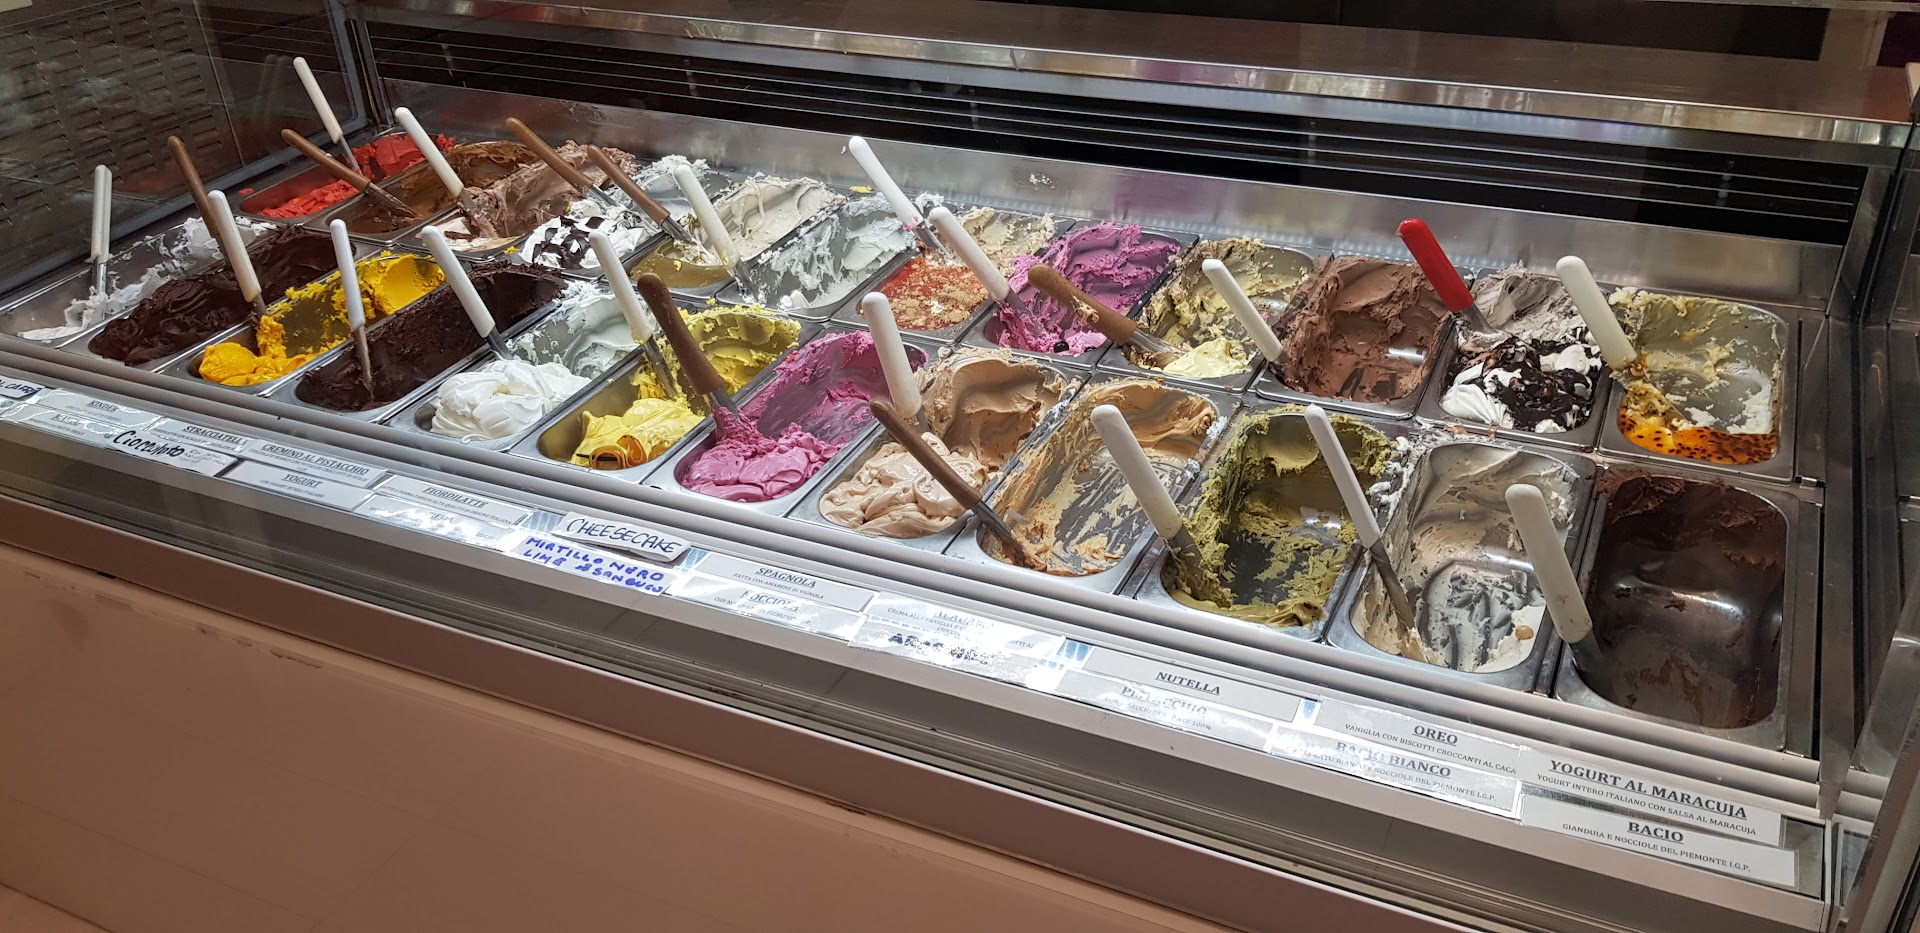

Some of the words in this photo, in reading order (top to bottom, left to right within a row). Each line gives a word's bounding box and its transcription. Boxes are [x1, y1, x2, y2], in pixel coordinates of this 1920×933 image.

[262, 444, 304, 460] CREMINO
[299, 453, 314, 462] AL
[315, 457, 369, 476] PISTACCHIO
[282, 473, 323, 489] YOGURT
[422, 486, 488, 508] FIORDILATTE
[566, 518, 682, 554] CHEESECAKE
[526, 537, 604, 564] MIRTILLO
[610, 561, 664, 581] NERO
[755, 567, 816, 589] SPAGNOLA
[1154, 671, 1221, 696] NUTELLA
[1345, 723, 1381, 739] VANIGLIA
[1382, 733, 1399, 743] CON
[1399, 737, 1435, 753] BISCOTTI
[1436, 746, 1482, 765] CROCCANTI
[1483, 759, 1494, 768] AL
[1495, 762, 1517, 775] CACA
[1411, 725, 1458, 747] OREO
[1389, 751, 1451, 779] BIANCO
[1374, 768, 1414, 782] NOCCIOLE
[1415, 776, 1431, 786] DEL
[1433, 780, 1476, 797] PIEMONTE
[1548, 759, 1621, 785] YOGURT
[1625, 780, 1647, 794] AL
[1652, 785, 1748, 820] MARACUJA
[1537, 773, 1571, 788] YOGURT
[1572, 782, 1604, 796] INTERO
[1605, 790, 1646, 807] ITALIANO
[1647, 802, 1666, 813] CON
[1667, 807, 1695, 820] SALSA
[1696, 814, 1708, 823] AL
[1709, 817, 1757, 836] MARACUJA
[1562, 823, 1605, 839] GIANDUIA
[1607, 833, 1613, 841] E
[1614, 834, 1659, 851] NOCCIOLE
[1660, 845, 1678, 856] DEL
[1680, 850, 1728, 867] PIEMONTE
[1729, 861, 1751, 872] I.G.P.
[1627, 822, 1684, 844] BACIO
